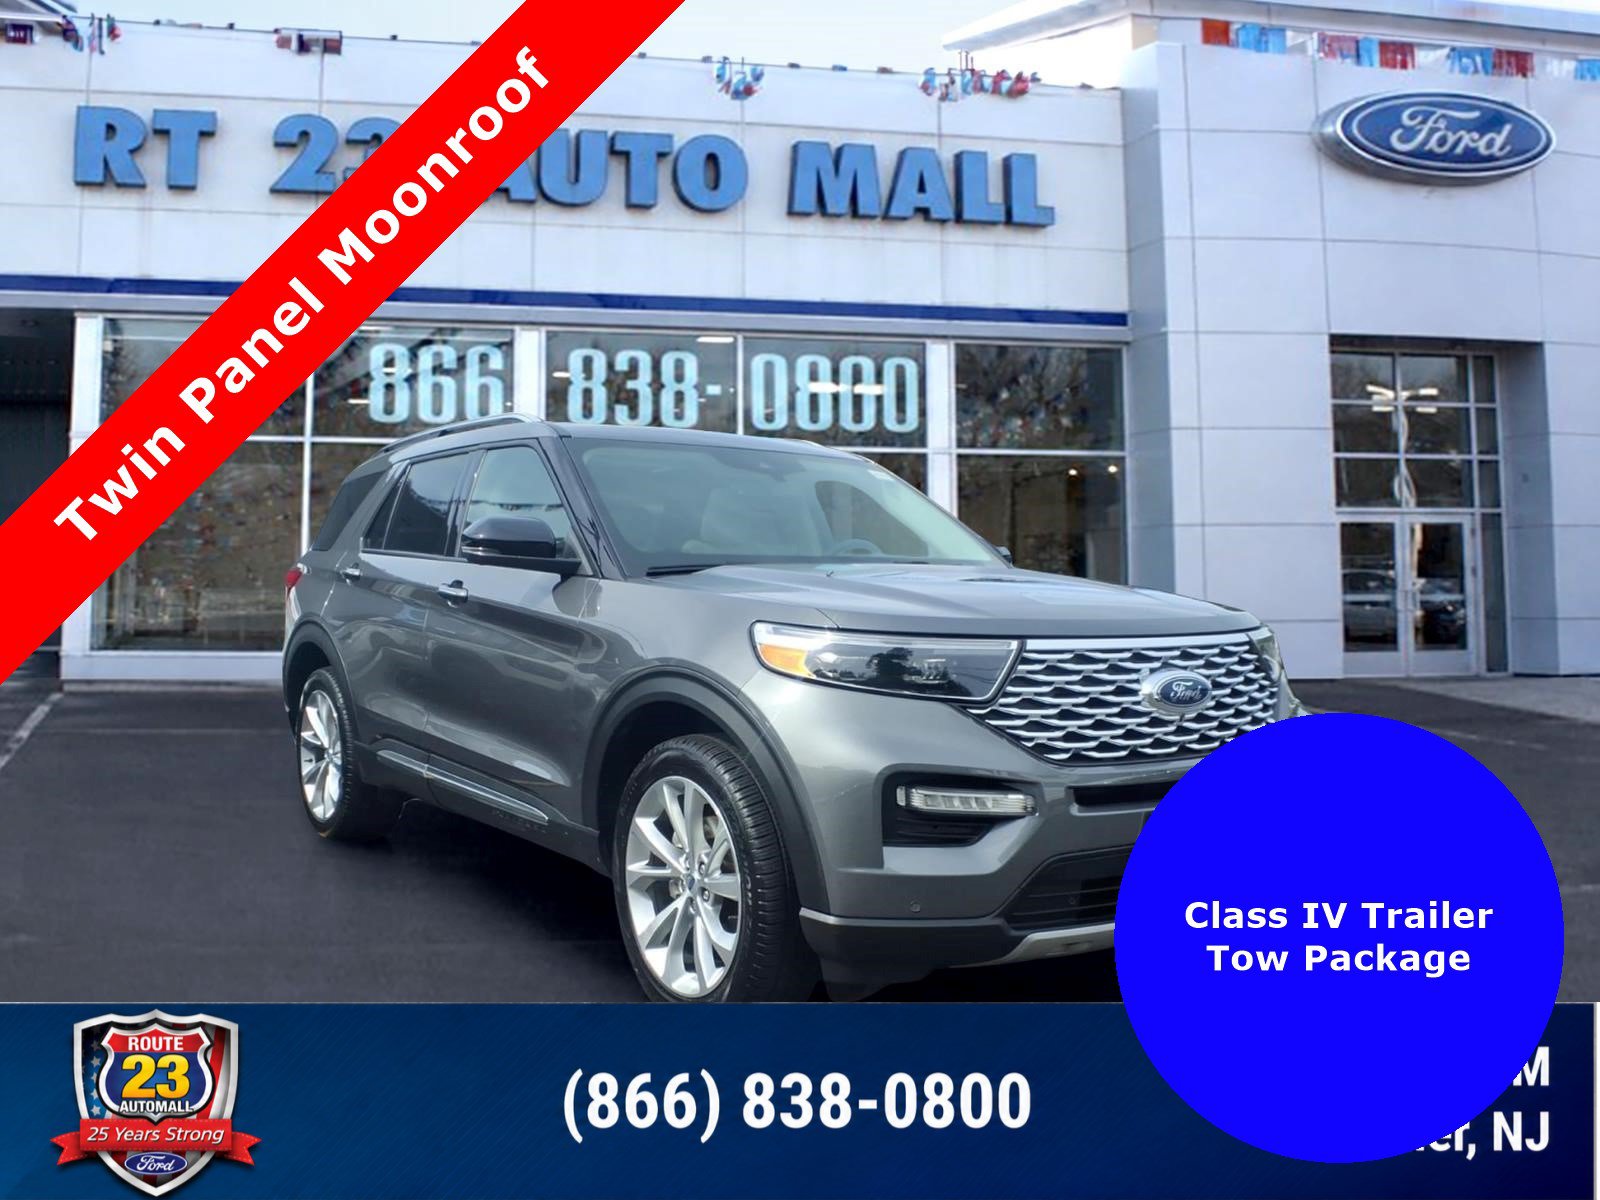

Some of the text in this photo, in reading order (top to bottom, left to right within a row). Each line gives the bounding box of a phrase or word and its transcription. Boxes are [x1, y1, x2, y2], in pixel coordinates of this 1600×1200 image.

[1390, 105, 1512, 157] Ford
[73, 105, 218, 190] RT
[788, 140, 1055, 227] MALL
[369, 343, 507, 424] 866
[1169, 681, 1203, 703] Ford
